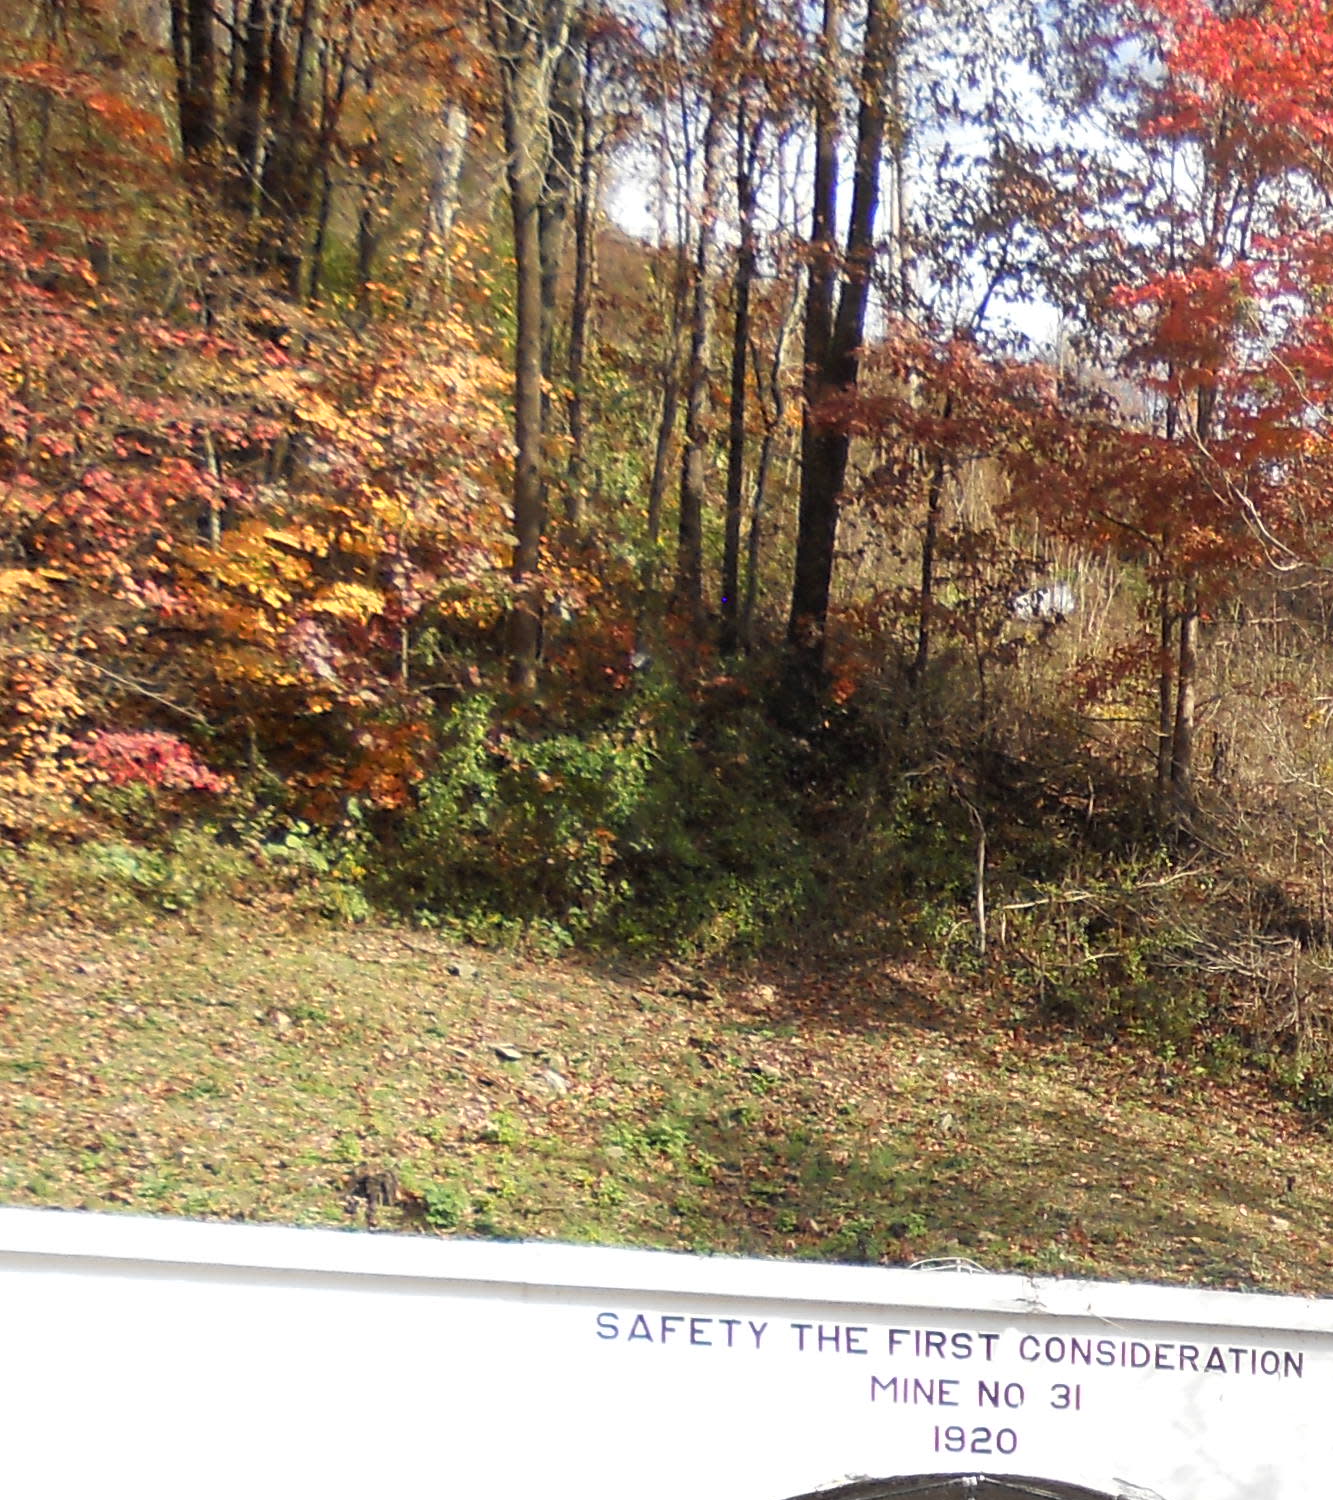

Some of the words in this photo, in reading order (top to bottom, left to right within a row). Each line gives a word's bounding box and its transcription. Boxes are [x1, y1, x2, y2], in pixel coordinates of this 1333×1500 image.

[596, 1312, 767, 1348] SAFETY
[790, 1323, 868, 1355] THE
[888, 1328, 1000, 1362] FIRST
[1019, 1334, 1305, 1378] CONSIDERATION
[870, 1375, 960, 1407] MINE
[978, 1380, 1025, 1409] NO
[1050, 1383, 1081, 1411] 31
[933, 1425, 1018, 1455] 1920
